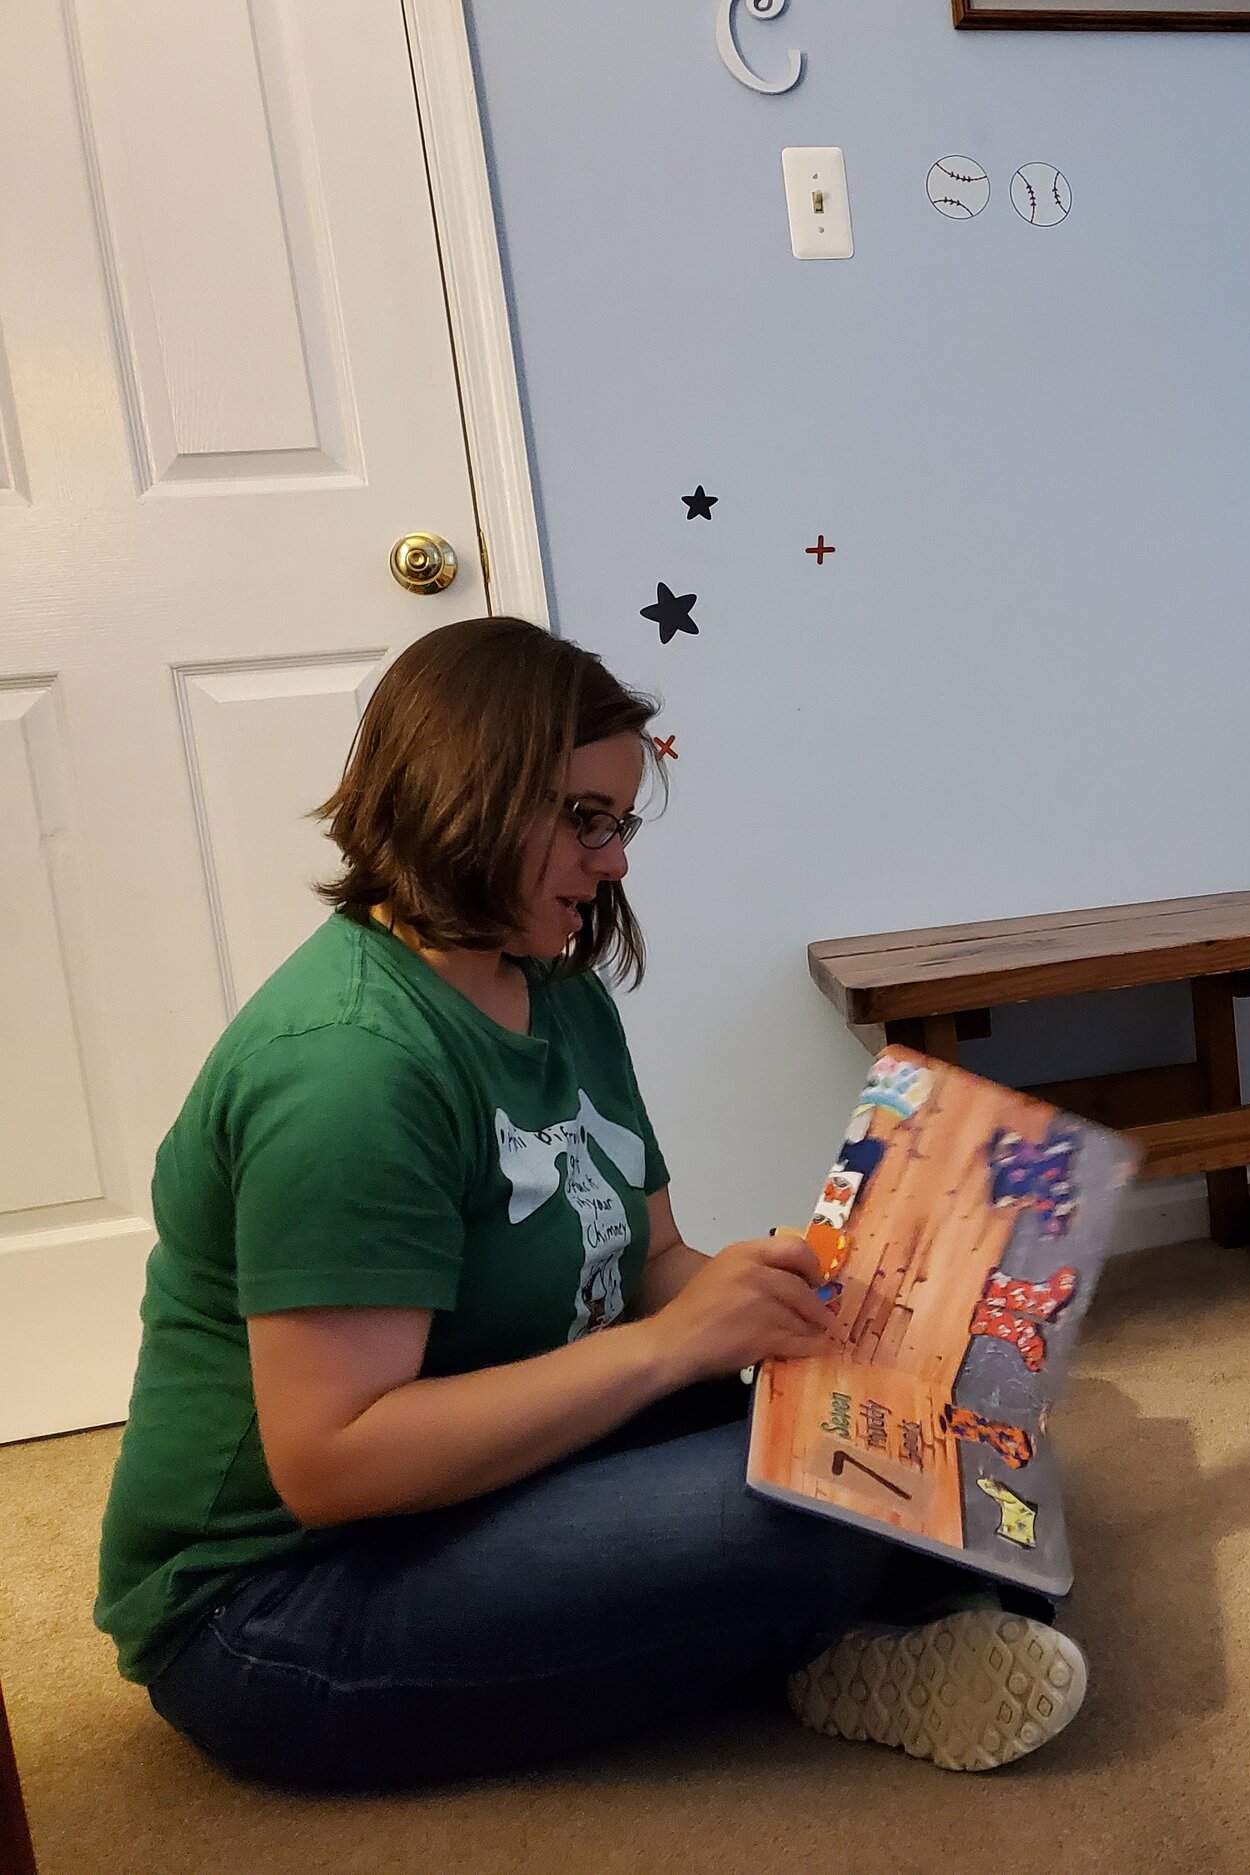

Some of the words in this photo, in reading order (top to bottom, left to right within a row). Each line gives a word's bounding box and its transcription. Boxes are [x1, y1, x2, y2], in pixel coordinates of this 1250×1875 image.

[586, 1197, 614, 1221] your
[820, 1391, 852, 1440] Seven
[831, 1450, 913, 1502] 7
